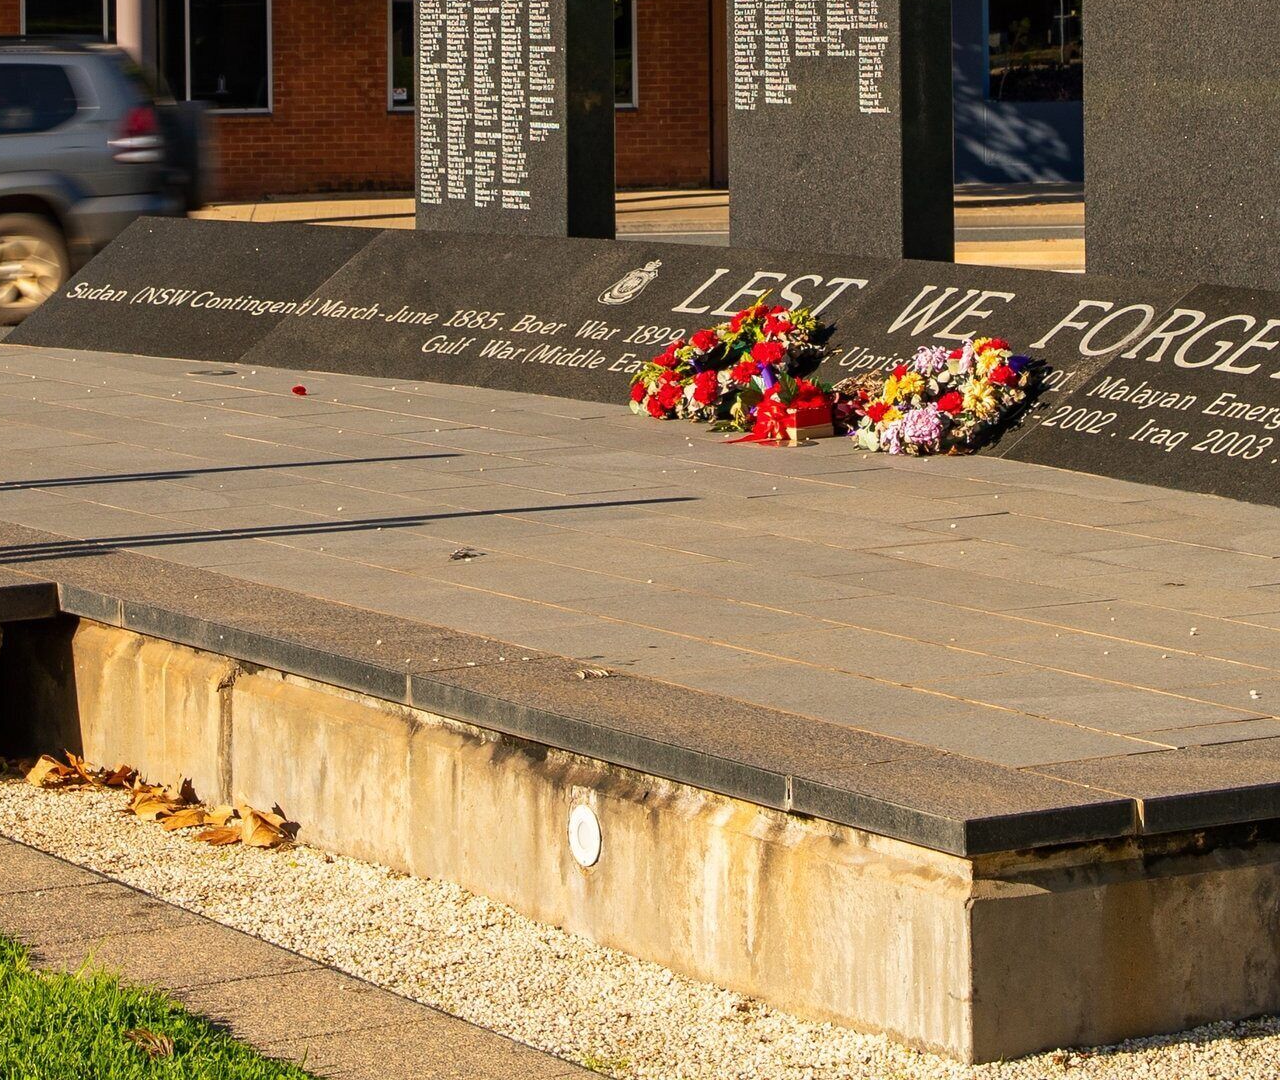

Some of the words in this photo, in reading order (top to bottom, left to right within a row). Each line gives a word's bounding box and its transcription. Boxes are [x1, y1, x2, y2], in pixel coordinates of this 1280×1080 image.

[66, 282, 127, 303] Sudan
[129, 286, 197, 307] (NSW
[191, 291, 320, 316] Contingent)
[507, 314, 567, 336] Boer
[575, 320, 621, 342] War
[671, 269, 868, 317] LEST
[887, 285, 1016, 340] WE
[421, 335, 477, 355] Gulf
[479, 338, 526, 359] War
[522, 343, 608, 370] (Middle
[1086, 376, 1205, 412] Malayan
[1128, 418, 1189, 452] Iraq
